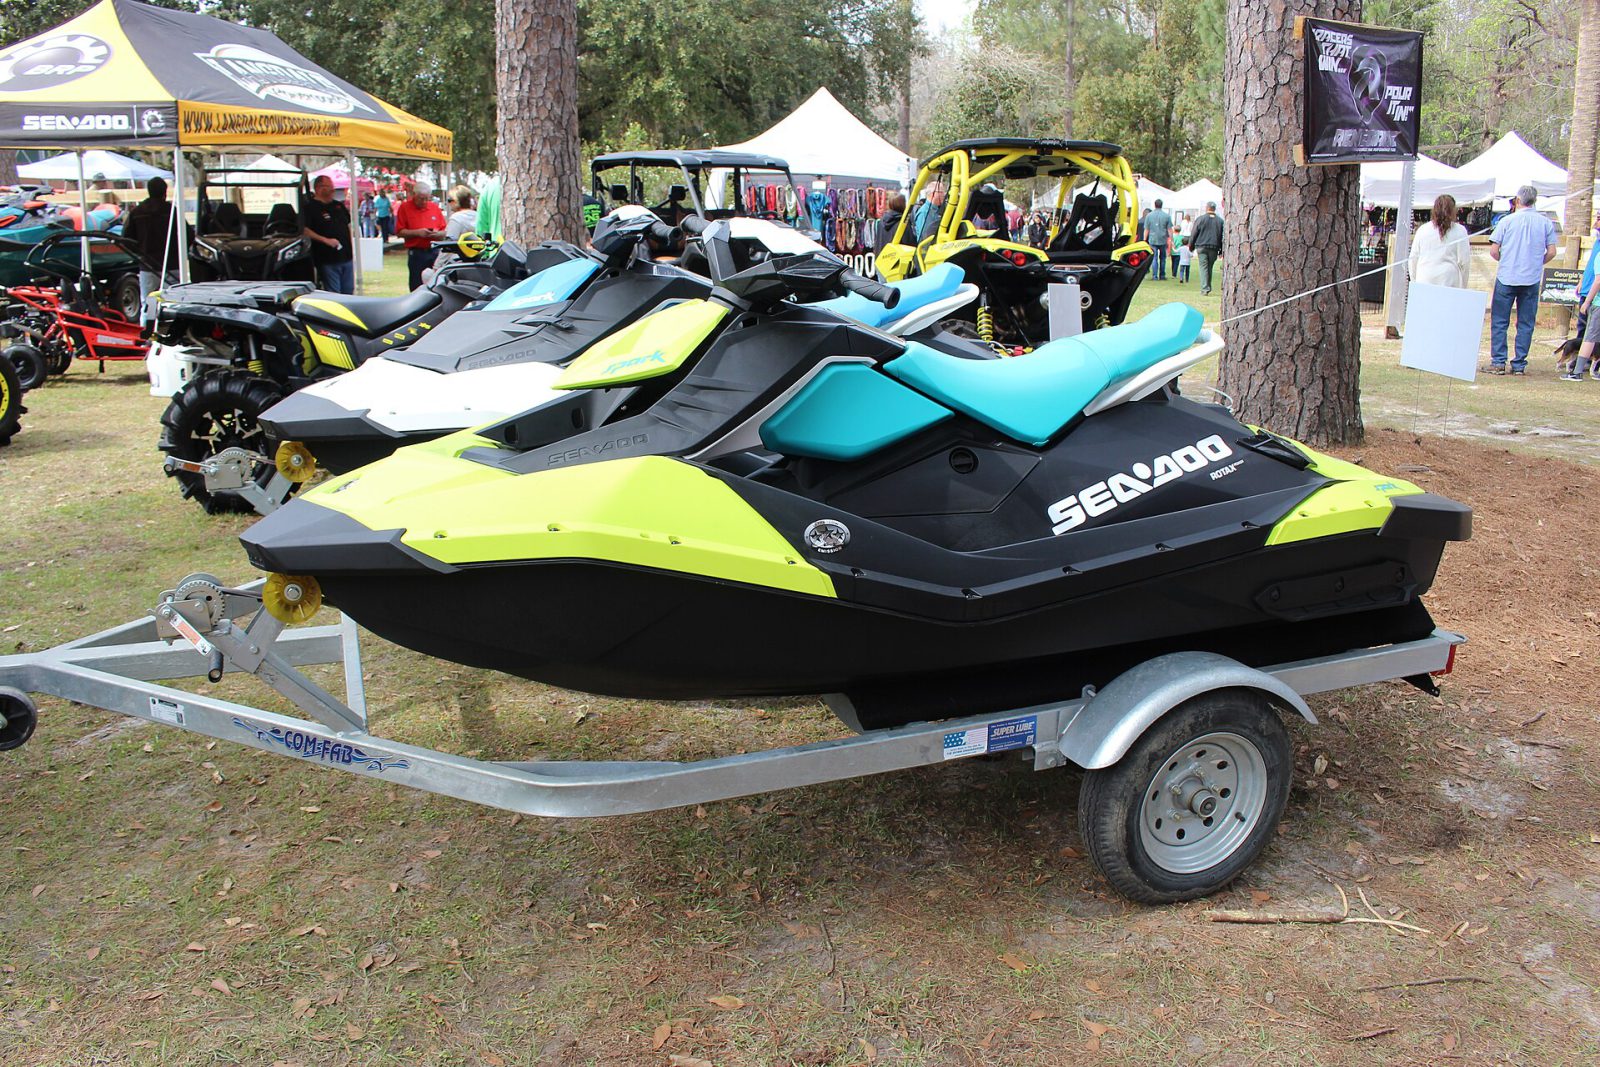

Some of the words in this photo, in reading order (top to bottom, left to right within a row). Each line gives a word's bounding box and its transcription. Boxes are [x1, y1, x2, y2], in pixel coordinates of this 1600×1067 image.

[1321, 42, 1352, 59] THAT
[23, 64, 97, 75] BRP
[1384, 85, 1413, 100] POUR
[1386, 99, 1400, 115] IT
[183, 110, 340, 137] WWW.LANGDALEPOWERSPORTS.COM
[511, 291, 555, 307] spark
[602, 350, 666, 375] spark
[1209, 463, 1237, 481] ROTAX
[991, 726, 1015, 738] SUPER
[1015, 721, 1035, 732] LUBE
[284, 731, 354, 764] COM-FAB
